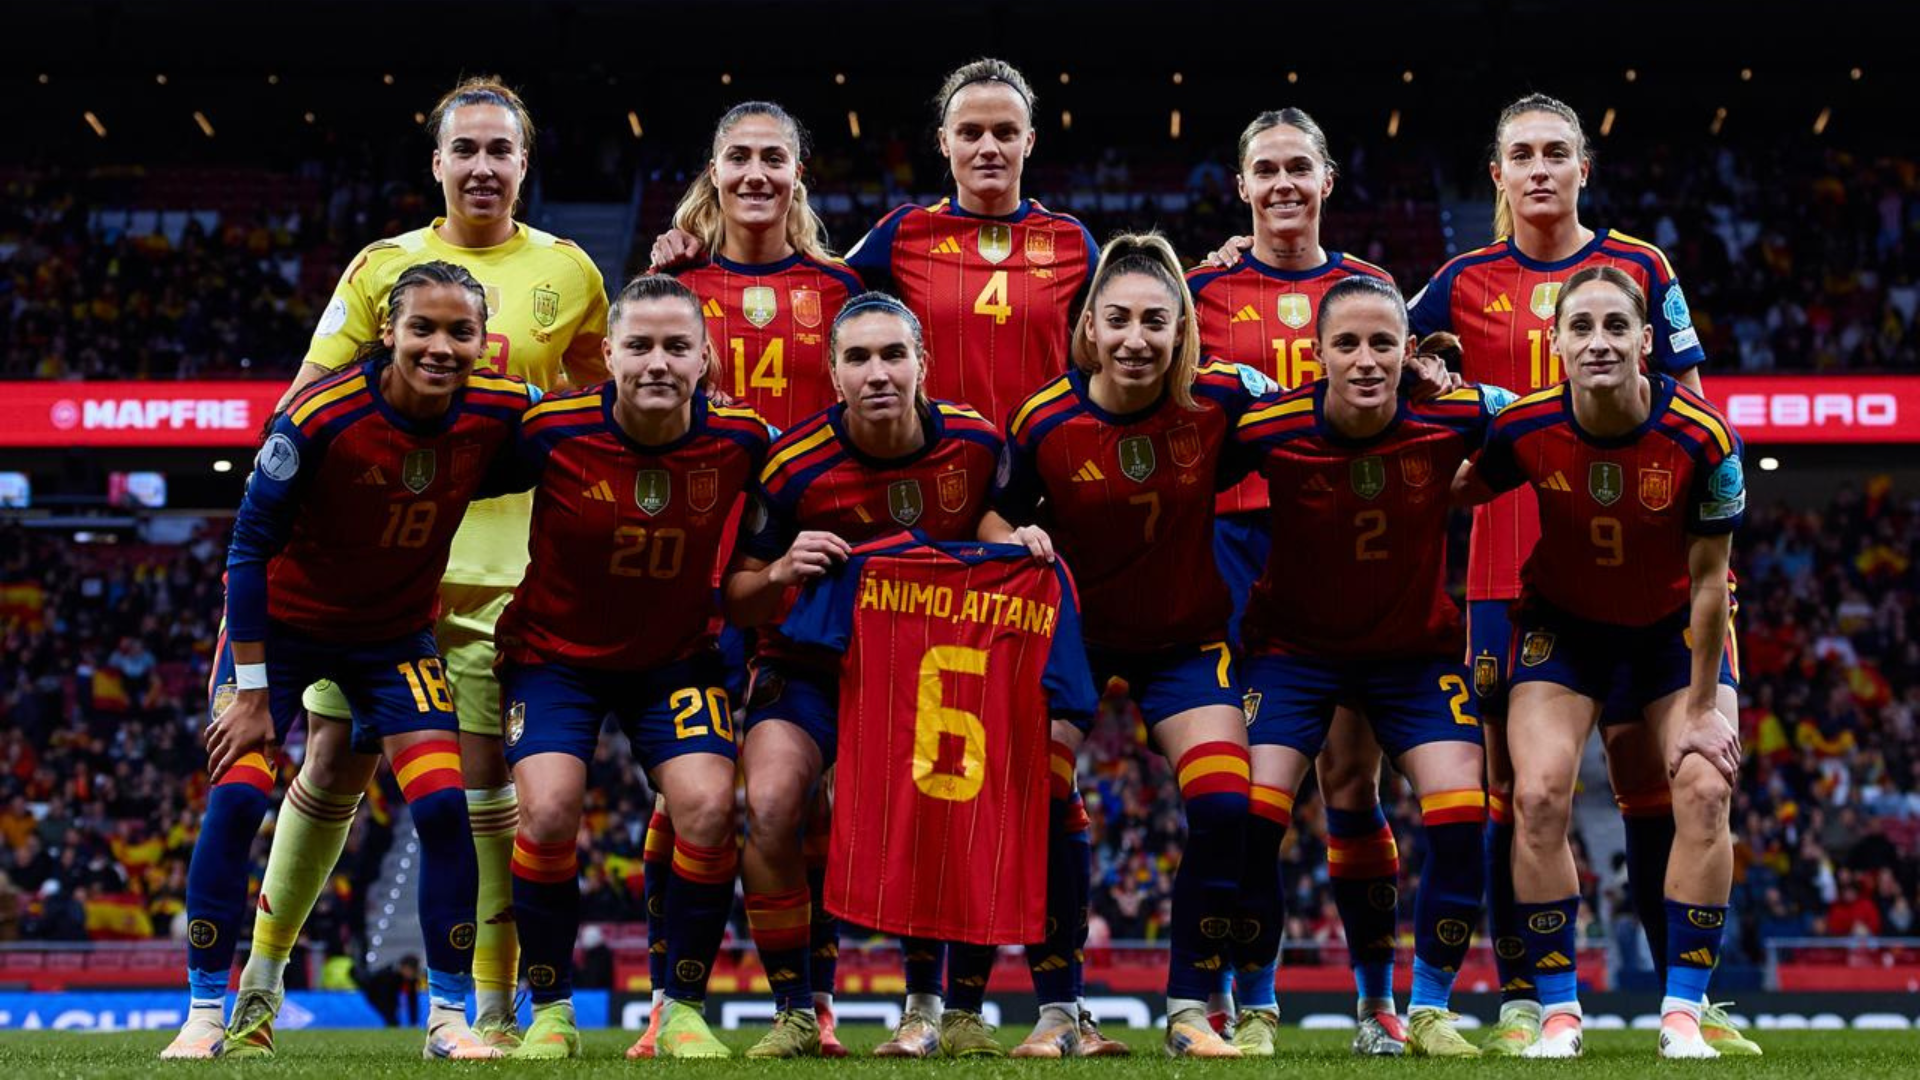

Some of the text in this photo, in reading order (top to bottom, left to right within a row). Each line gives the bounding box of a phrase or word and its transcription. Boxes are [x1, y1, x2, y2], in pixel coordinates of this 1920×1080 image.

[974, 270, 1012, 325] 4
[730, 337, 788, 397] 14
[1272, 339, 1327, 390] 16
[82, 399, 249, 429] MAPFRE
[1728, 394, 1897, 426] EBRO
[379, 500, 438, 549] 18
[1129, 491, 1161, 542] 7
[1353, 508, 1389, 562] 2
[1590, 515, 1625, 567] 9
[609, 525, 686, 580] 20
[397, 657, 455, 713] 18
[1201, 641, 1232, 688] 7
[669, 686, 735, 743] 20
[912, 643, 988, 803] 6
[1438, 674, 1479, 726] 2
